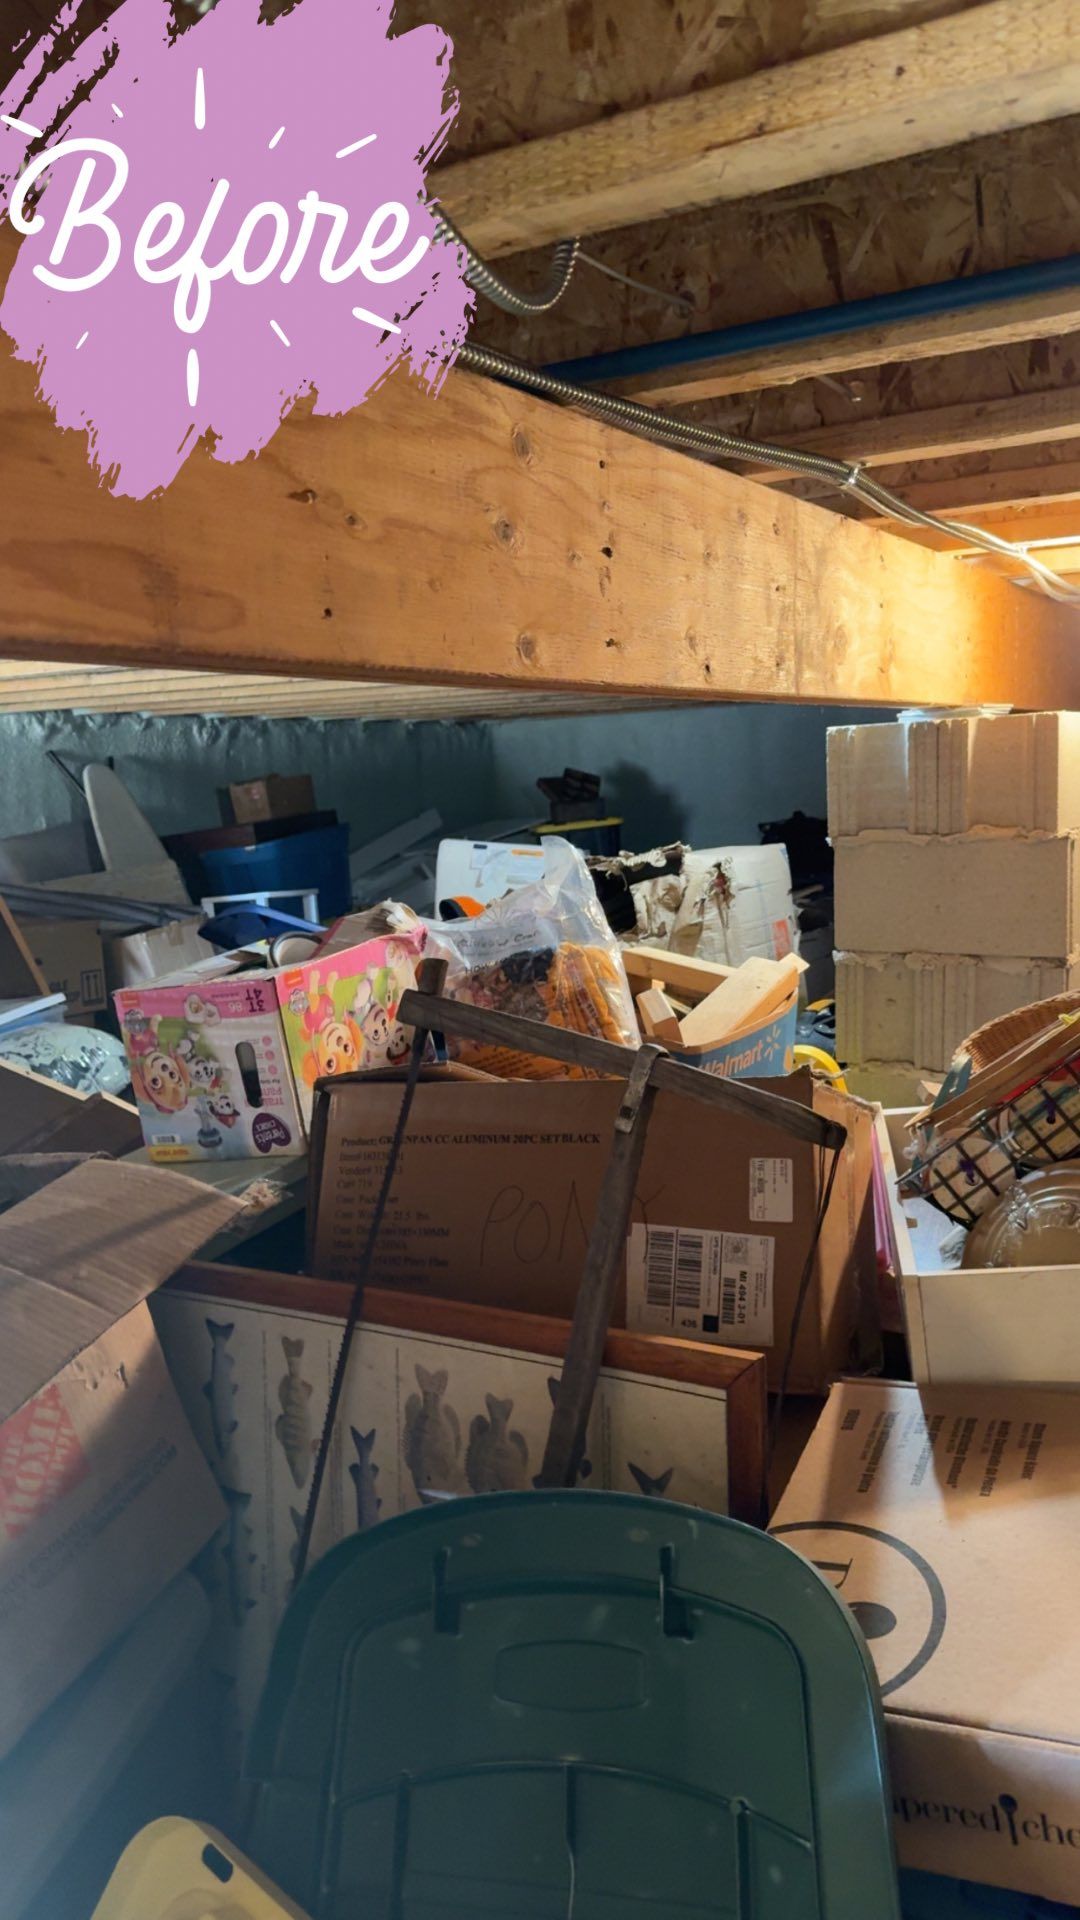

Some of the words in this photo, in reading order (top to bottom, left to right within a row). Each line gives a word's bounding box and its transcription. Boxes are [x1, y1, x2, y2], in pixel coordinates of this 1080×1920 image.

[379, 1135, 432, 1147] GRENPAN
[451, 1133, 511, 1145] ALUMINUM
[562, 1133, 600, 1144] BLACK
[893, 1797, 1001, 1834] pered
